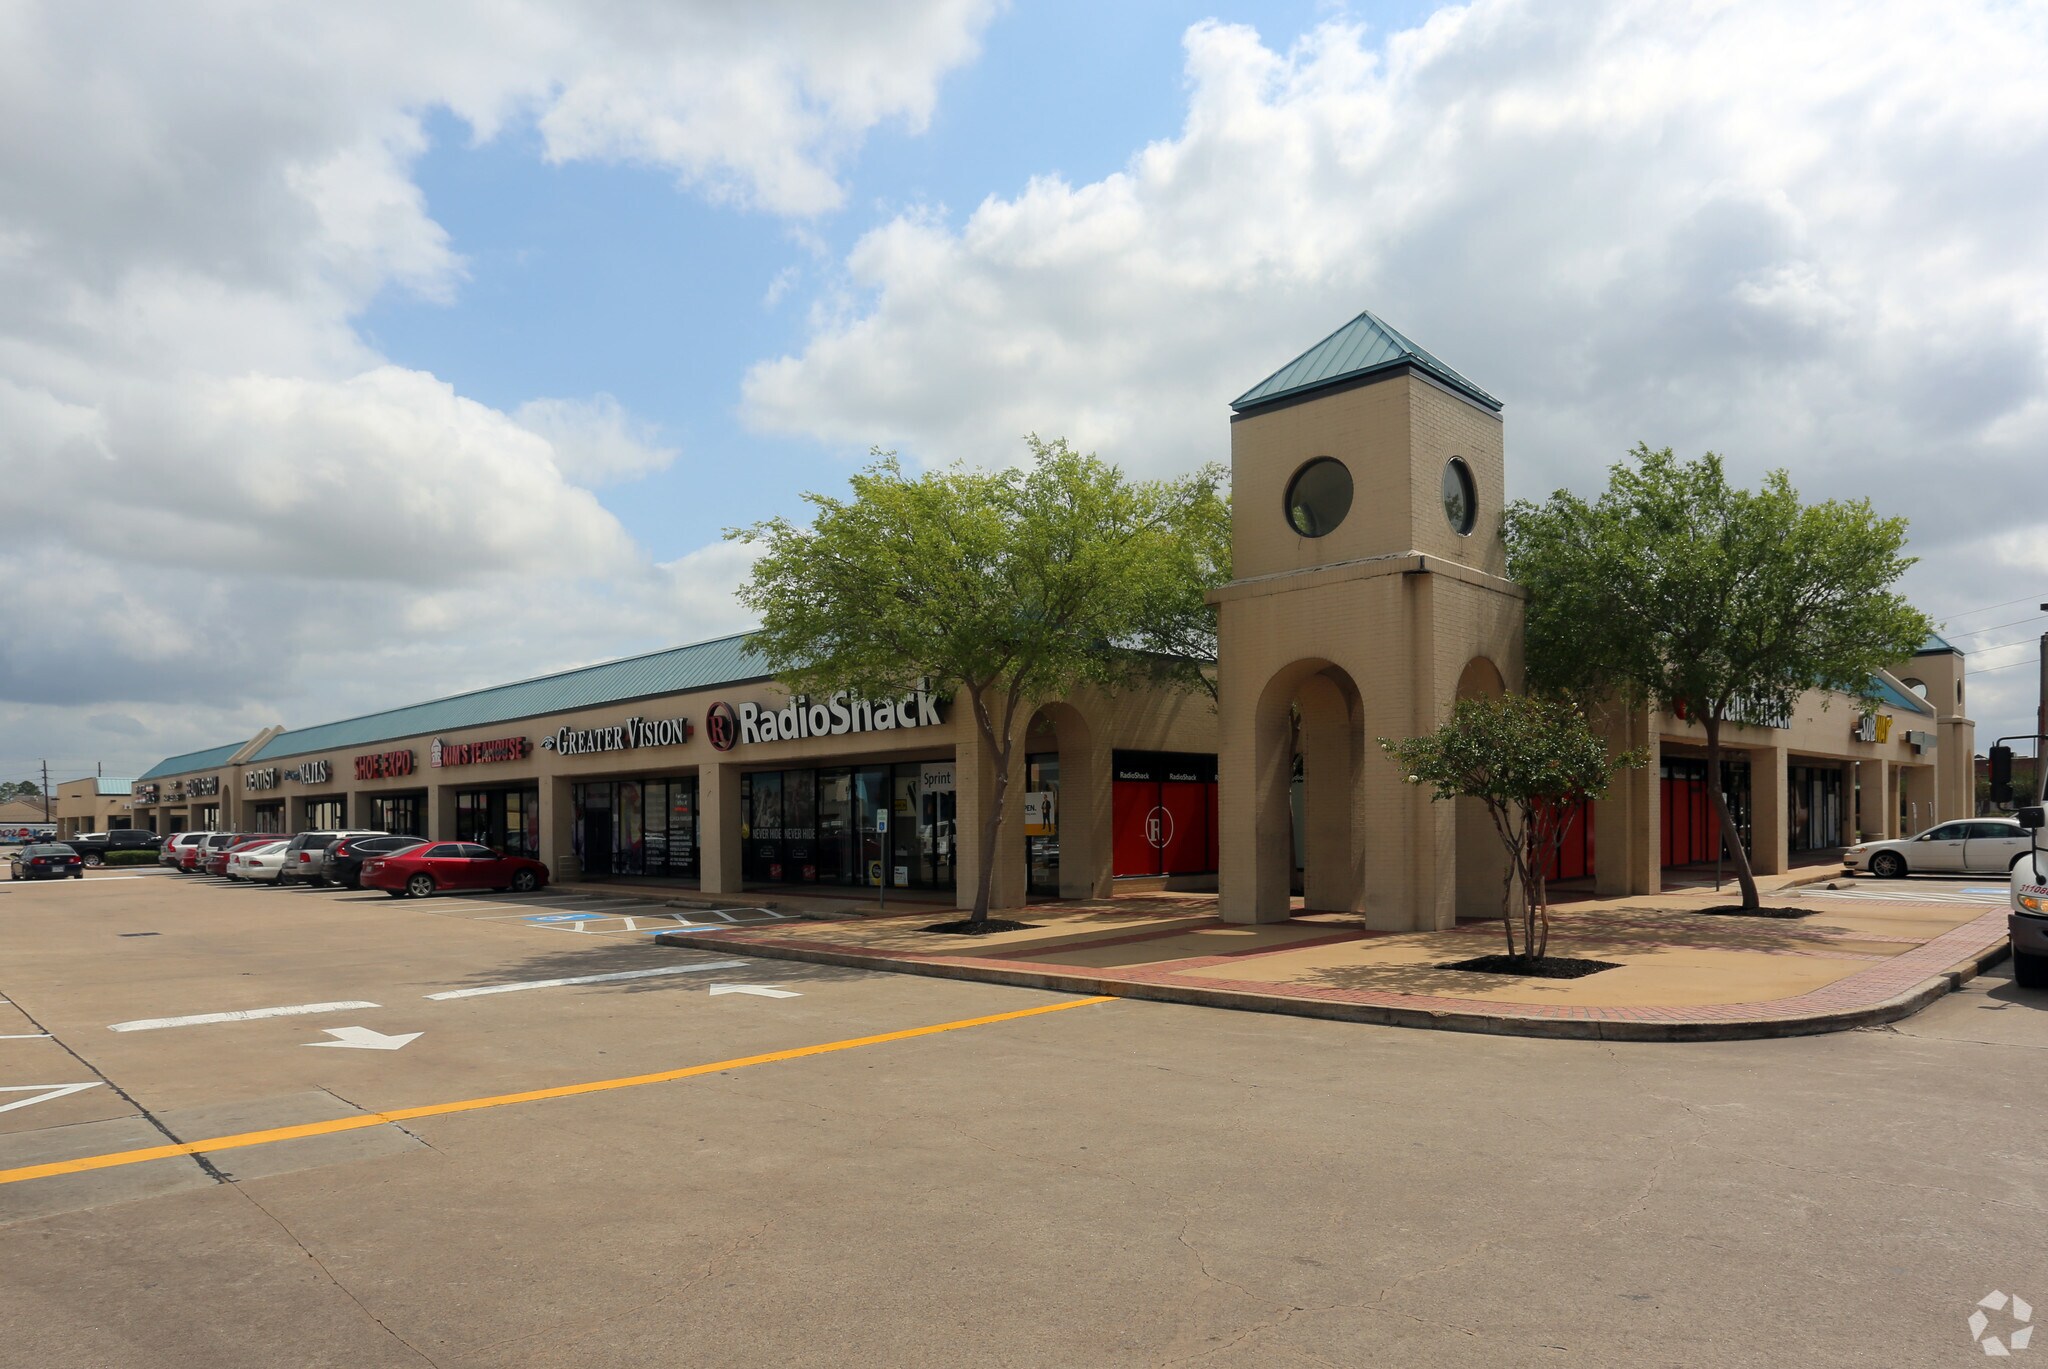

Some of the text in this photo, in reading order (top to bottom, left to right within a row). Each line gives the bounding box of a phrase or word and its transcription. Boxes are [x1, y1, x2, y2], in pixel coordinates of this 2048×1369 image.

[738, 676, 941, 744] RadioShack
[556, 717, 685, 756] GREATER VISION
[442, 737, 523, 767] KIM'S TEAHOUSE
[298, 760, 327, 784] NAILS
[354, 750, 412, 781] SHOE EXPO
[1120, 771, 1149, 780] RadioShack
[1169, 773, 1197, 781] RadioShack
[245, 767, 276, 791] DENTIST
[924, 772, 951, 788] Sprint
[752, 828, 782, 840] NEVER HIDE
[784, 828, 816, 840] NEVER HIDE
